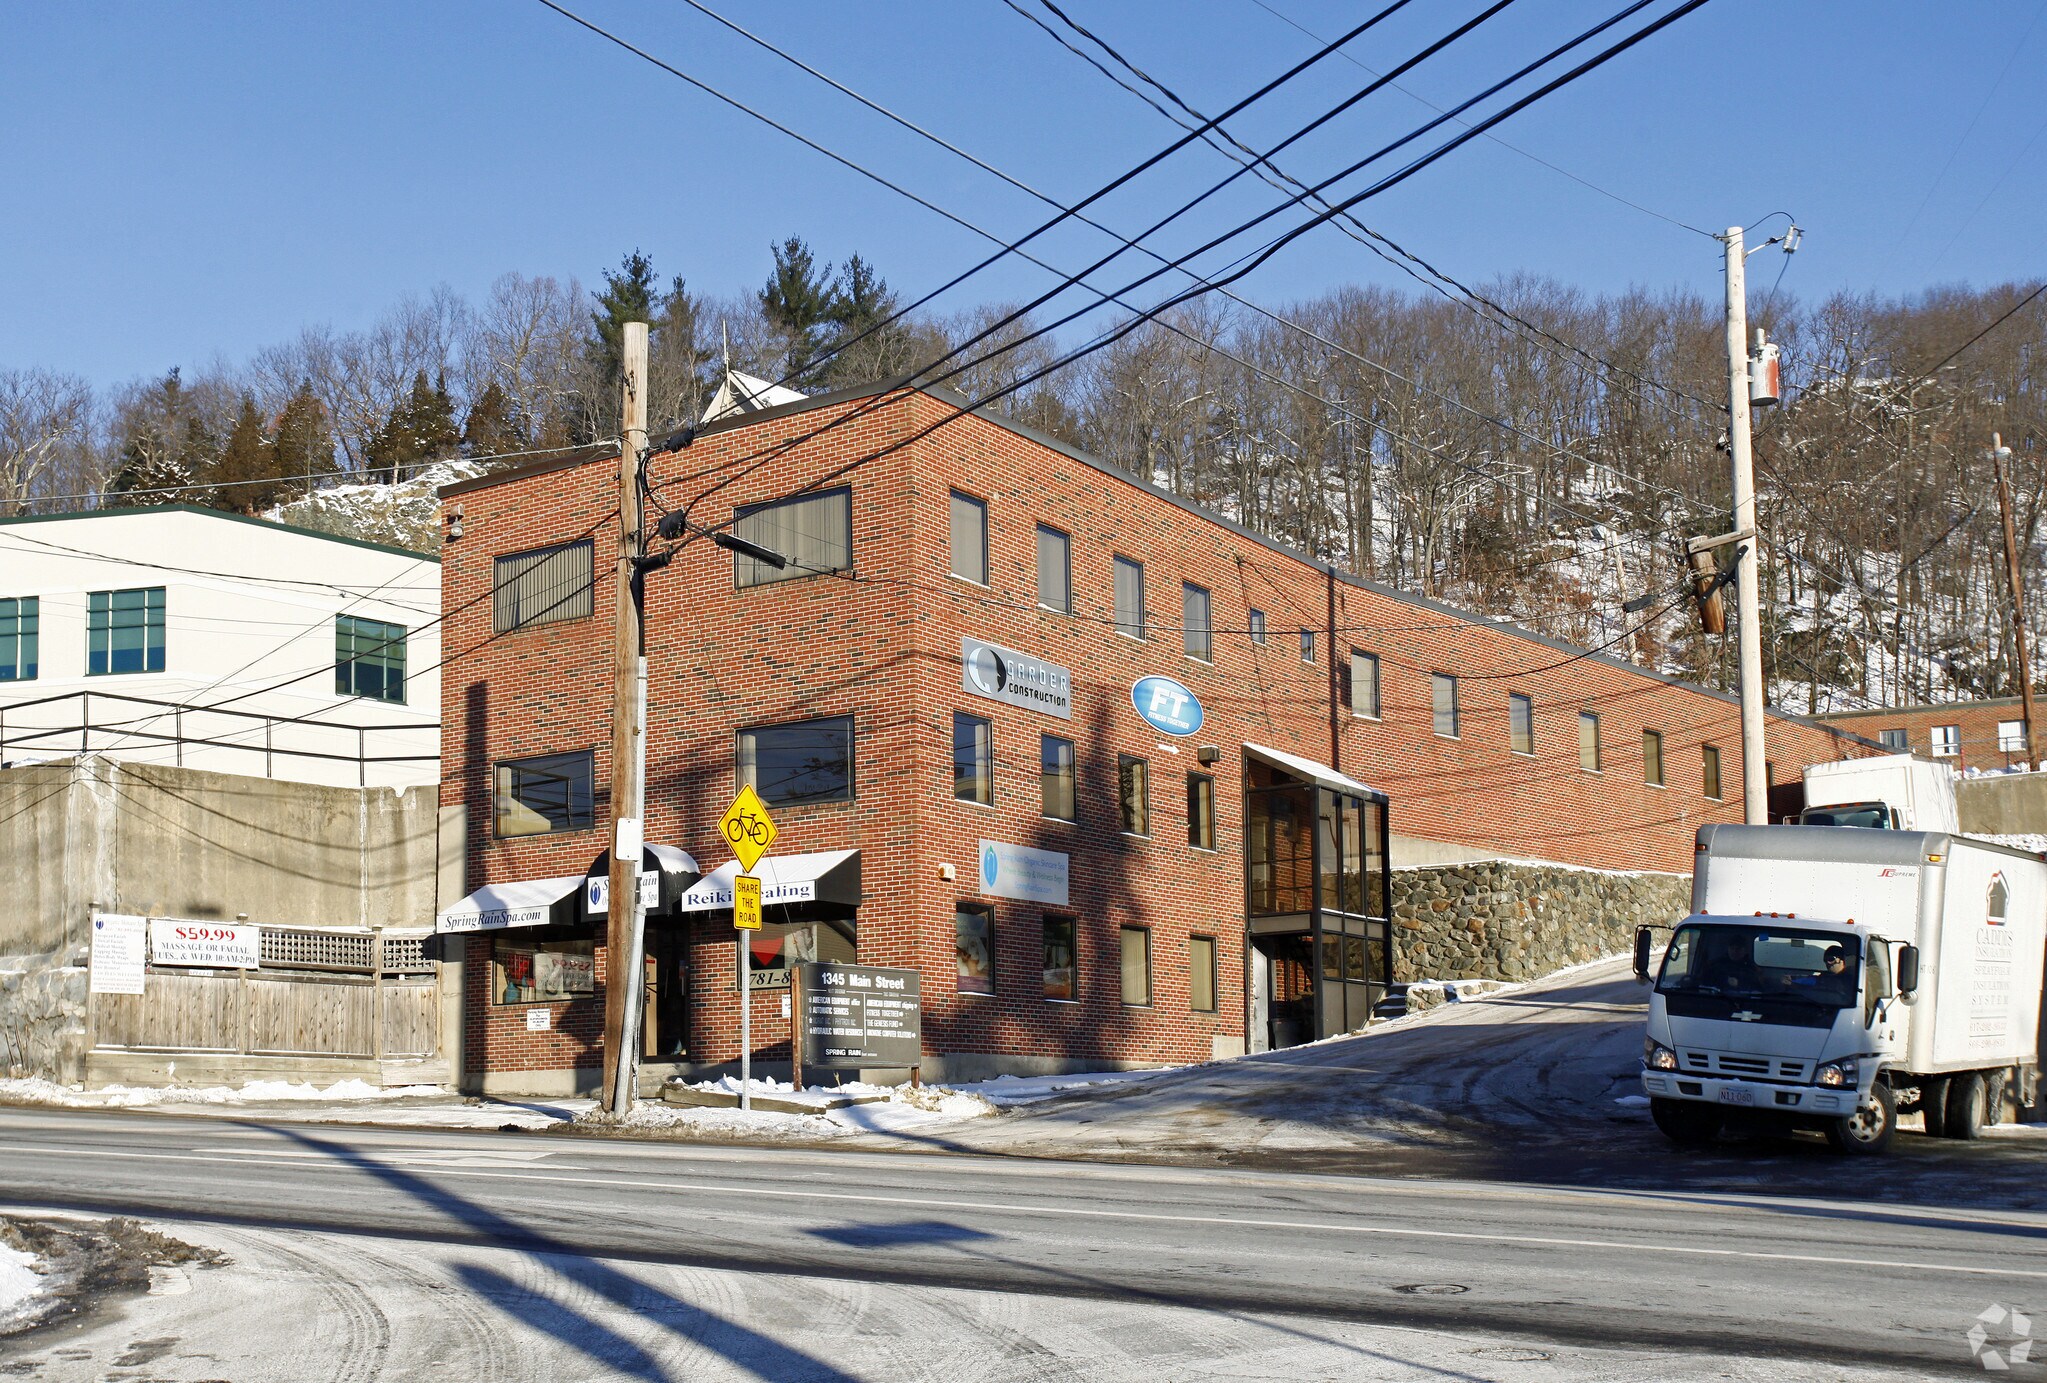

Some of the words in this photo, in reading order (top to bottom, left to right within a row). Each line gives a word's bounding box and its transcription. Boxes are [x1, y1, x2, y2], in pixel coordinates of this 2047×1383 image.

[1149, 686, 1189, 718] FT
[1147, 711, 1167, 723] FITNESS
[1166, 716, 1190, 730] TOGETHER
[1058, 861, 1066, 871] Spa
[737, 882, 759, 895] SHARE
[687, 890, 732, 906] Reiki
[742, 897, 754, 909] THE
[445, 910, 541, 930] SpringRainSpa.com
[739, 911, 757, 923] ROAD
[175, 926, 236, 941] $59.99
[161, 942, 204, 951] MASSAGE
[206, 943, 218, 952] OR
[221, 944, 250, 955] FACIAL
[180, 952, 187, 960] &
[821, 972, 845, 986] 1345
[849, 973, 871, 988] Main
[875, 975, 905, 990] Street
[825, 1048, 846, 1056] SPRING
